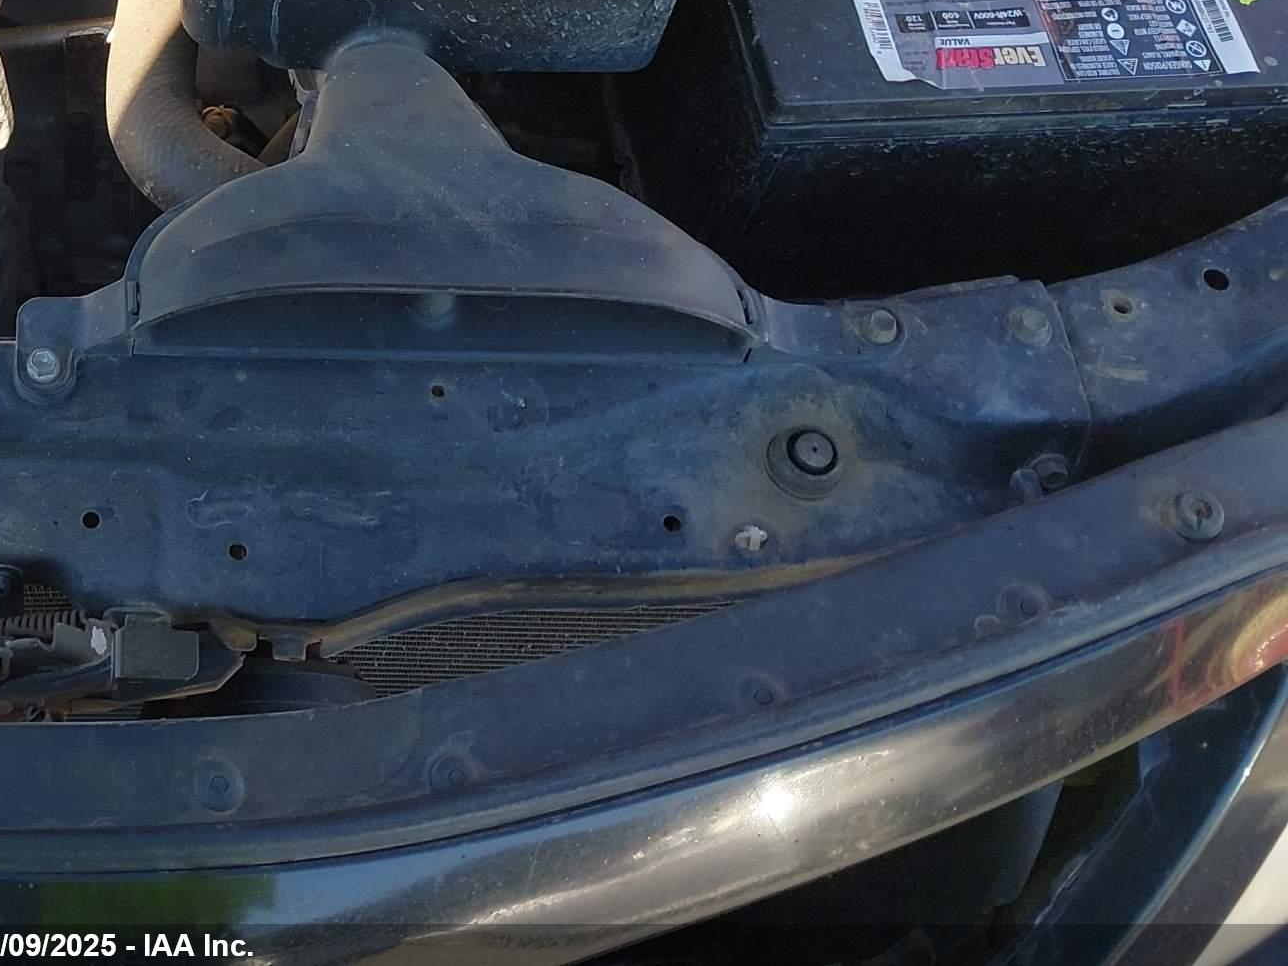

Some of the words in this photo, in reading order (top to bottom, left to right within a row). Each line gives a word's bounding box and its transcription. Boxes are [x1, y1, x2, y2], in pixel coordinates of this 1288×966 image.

[905, 14, 923, 23] 120
[939, 37, 971, 46] VALUE
[936, 45, 1047, 71] EverStart
